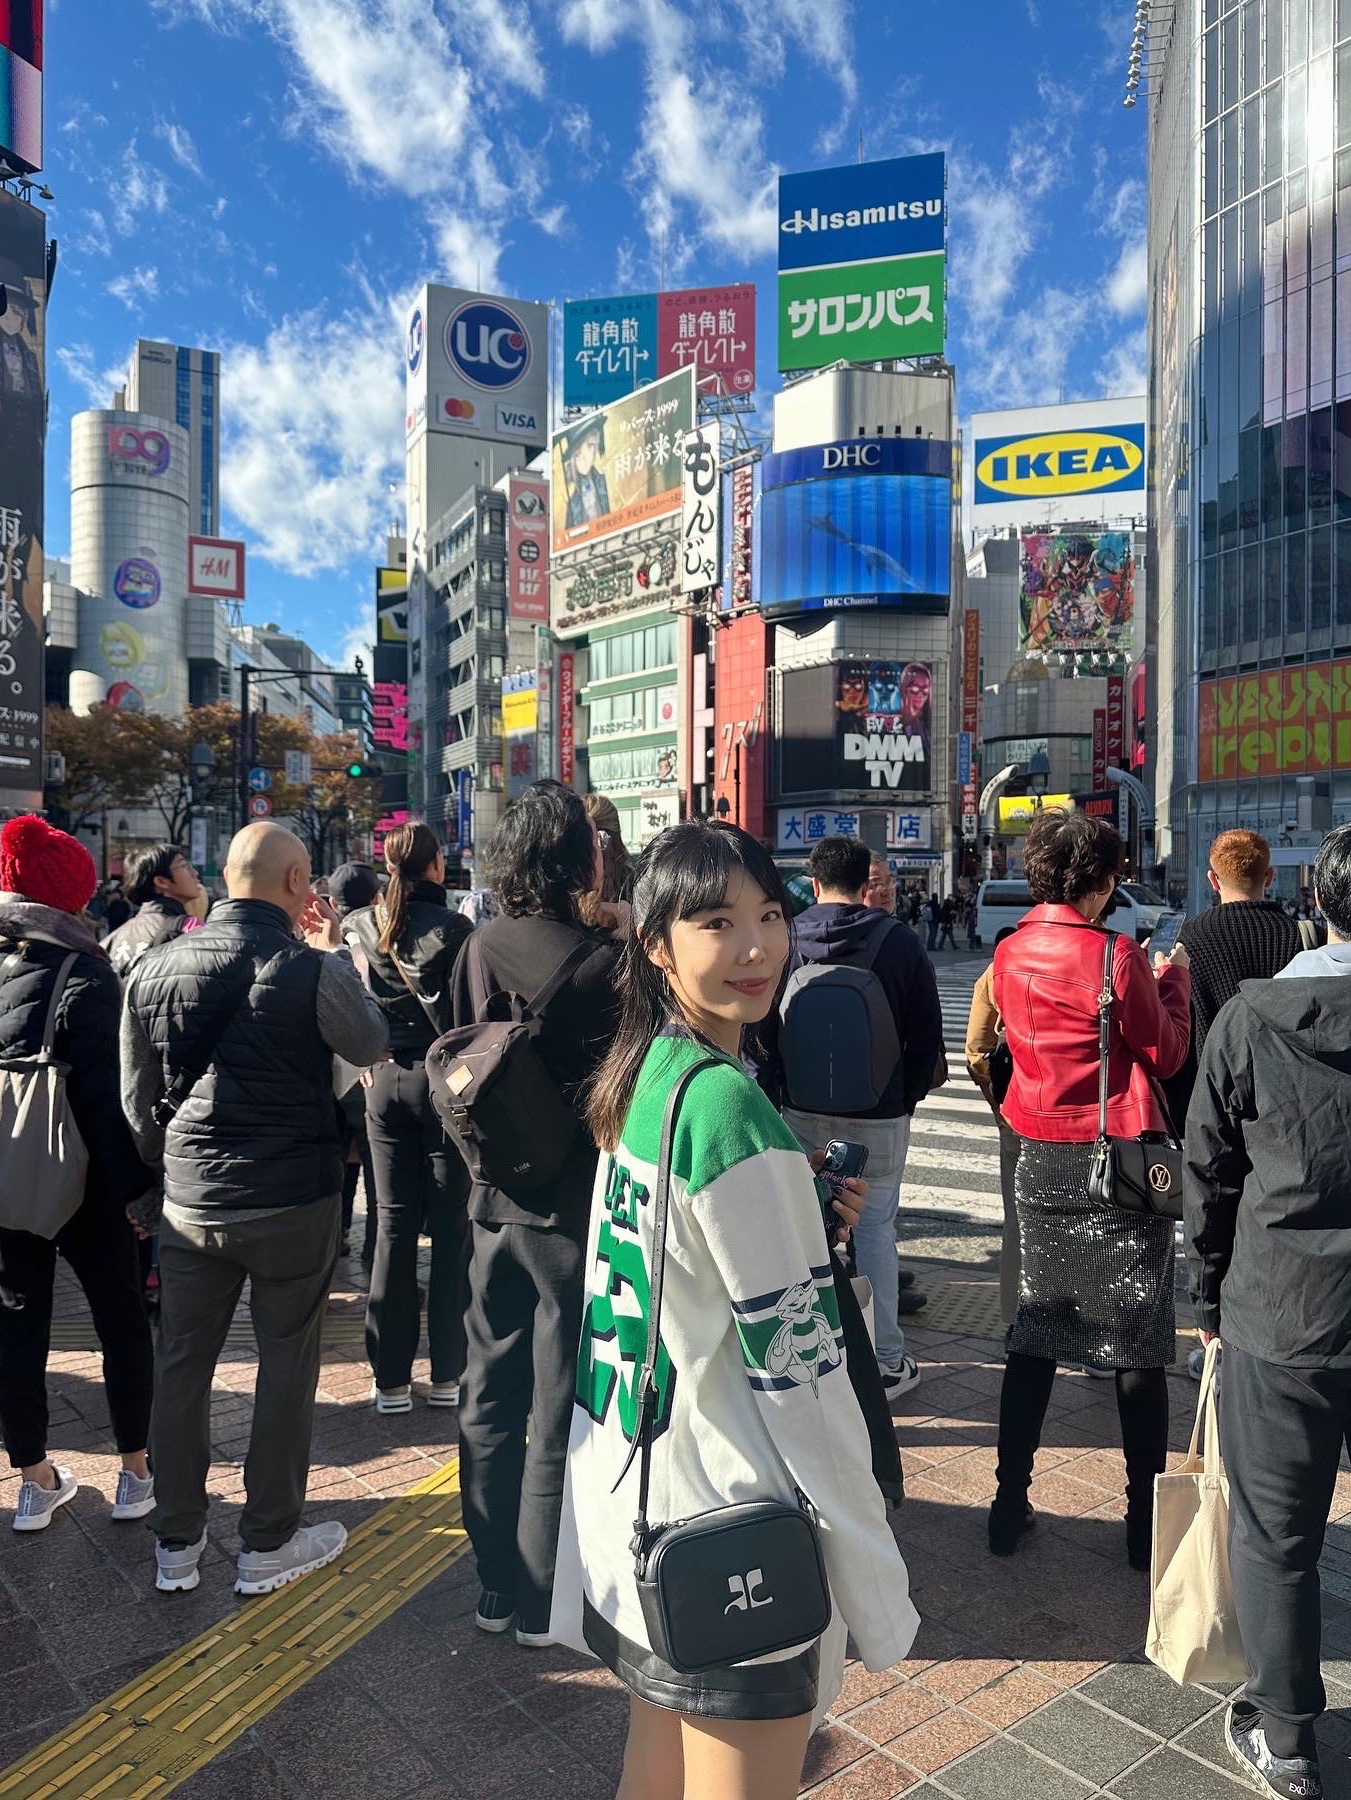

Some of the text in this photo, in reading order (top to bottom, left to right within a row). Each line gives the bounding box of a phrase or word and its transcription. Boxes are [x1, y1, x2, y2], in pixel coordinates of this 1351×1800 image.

[781, 198, 941, 234] Hisamitsu
[679, 308, 736, 339] 龍角散
[788, 285, 933, 338] サロンパス
[583, 317, 638, 348] 龍角散
[500, 410, 537, 430] VISA
[106, 422, 170, 475] 109
[822, 443, 881, 469] DHC
[991, 445, 1132, 483] IKEA
[683, 442, 717, 582] もんじゃ
[200, 557, 231, 578] H&M
[823, 595, 878, 607] DHC Channel
[1212, 664, 1351, 728] VAUN
[1108, 685, 1122, 749] カラオケ
[843, 732, 926, 762] DMM
[864, 760, 905, 788] TV
[785, 814, 921, 841] 大盛堂店
